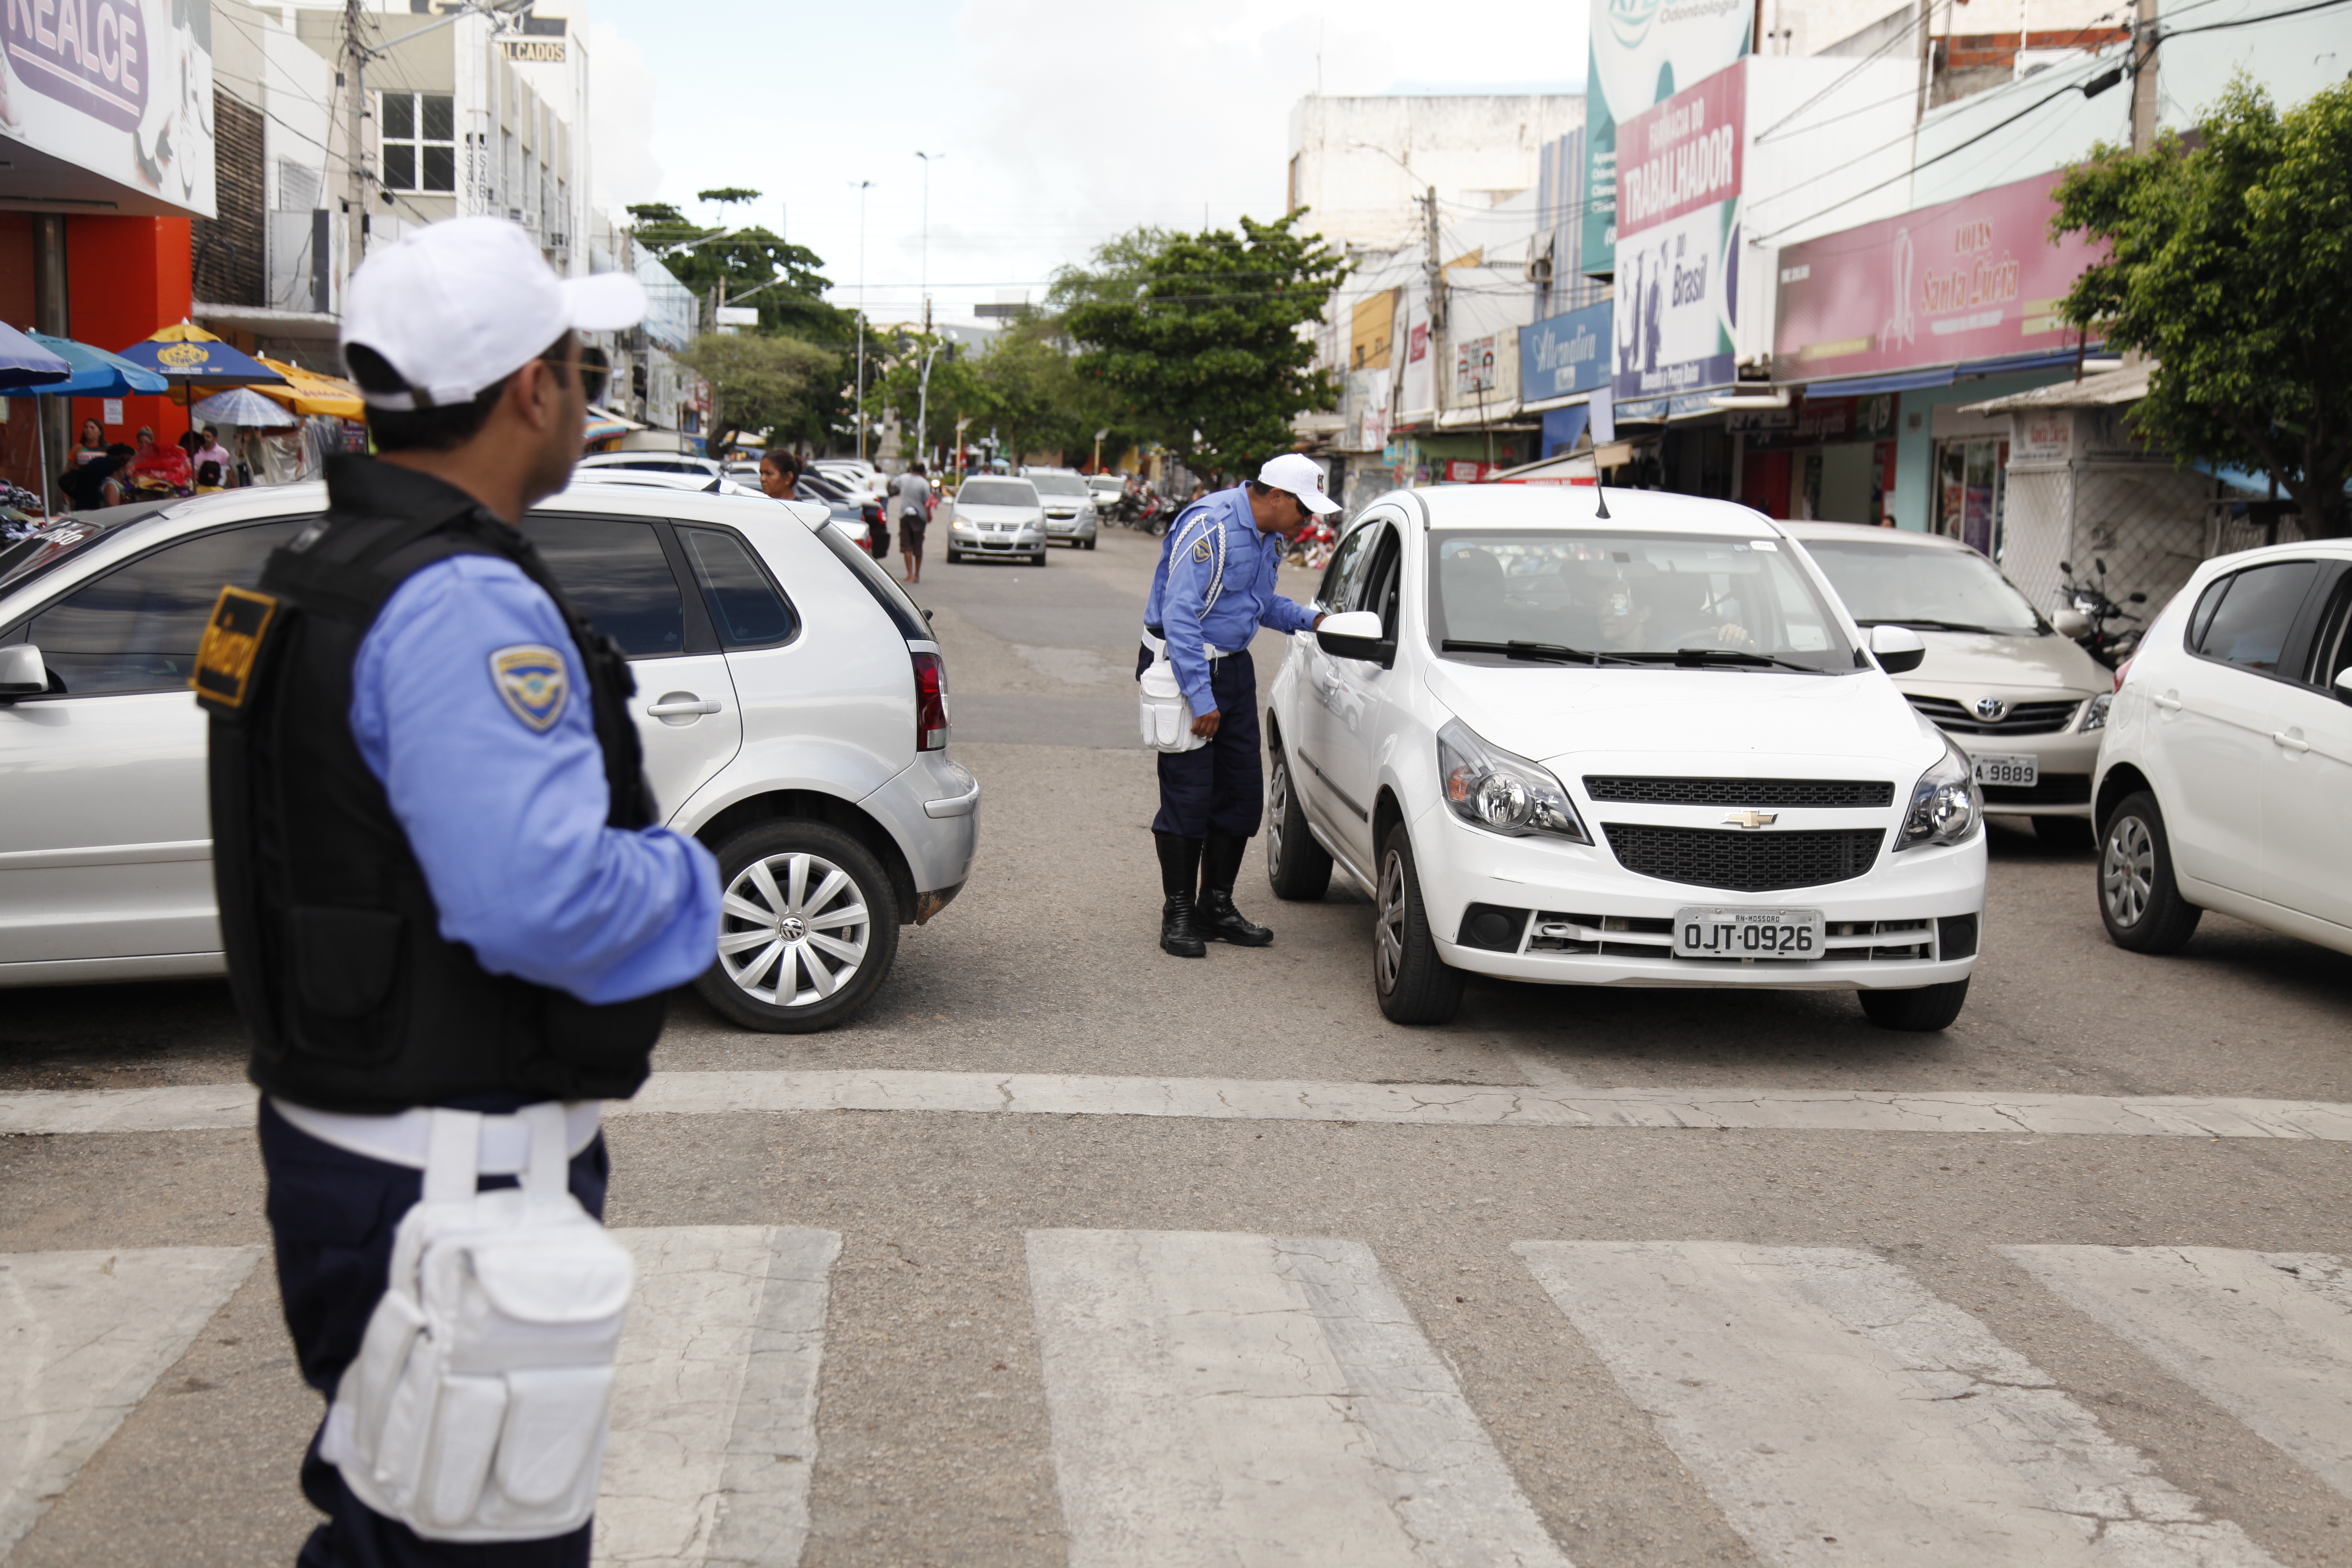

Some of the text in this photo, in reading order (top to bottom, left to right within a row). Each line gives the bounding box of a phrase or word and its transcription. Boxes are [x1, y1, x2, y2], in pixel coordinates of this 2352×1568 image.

[1624, 124, 1734, 225] TRABALHADOR
[1672, 253, 1708, 308] Brasil
[1921, 269, 1967, 314] Santa
